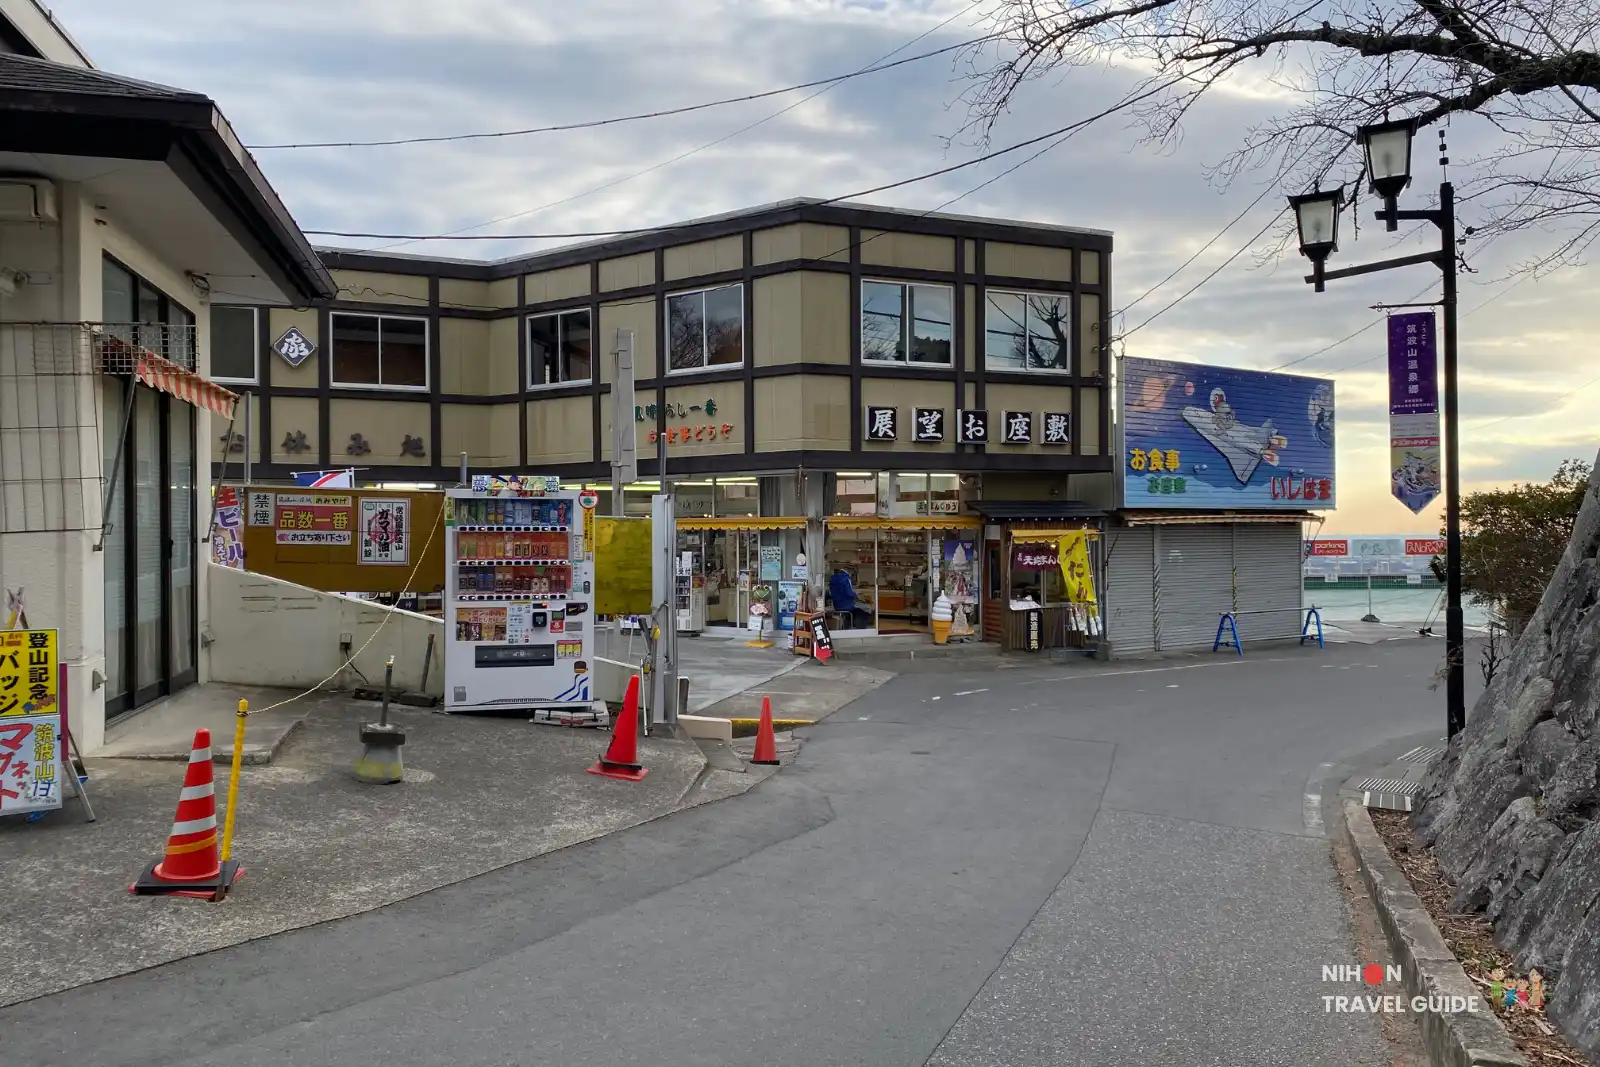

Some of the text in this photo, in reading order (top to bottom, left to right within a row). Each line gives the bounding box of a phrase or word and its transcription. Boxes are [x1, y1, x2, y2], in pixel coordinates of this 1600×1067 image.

[1406, 324, 1419, 394] 筑波山温泉郷
[647, 423, 734, 444] お食事どうぞ
[871, 409, 1069, 442] 展望お座敷
[1129, 448, 1181, 471] お食事
[1271, 476, 1332, 500] いしはま
[254, 493, 270, 525] 禁煙
[279, 511, 349, 529] 品数一番
[378, 508, 390, 552] ガマの油
[1315, 542, 1345, 553] parking
[0, 650, 19, 714] バッジ
[28, 632, 49, 700] 登山記念
[34, 723, 55, 781] 筑波山
